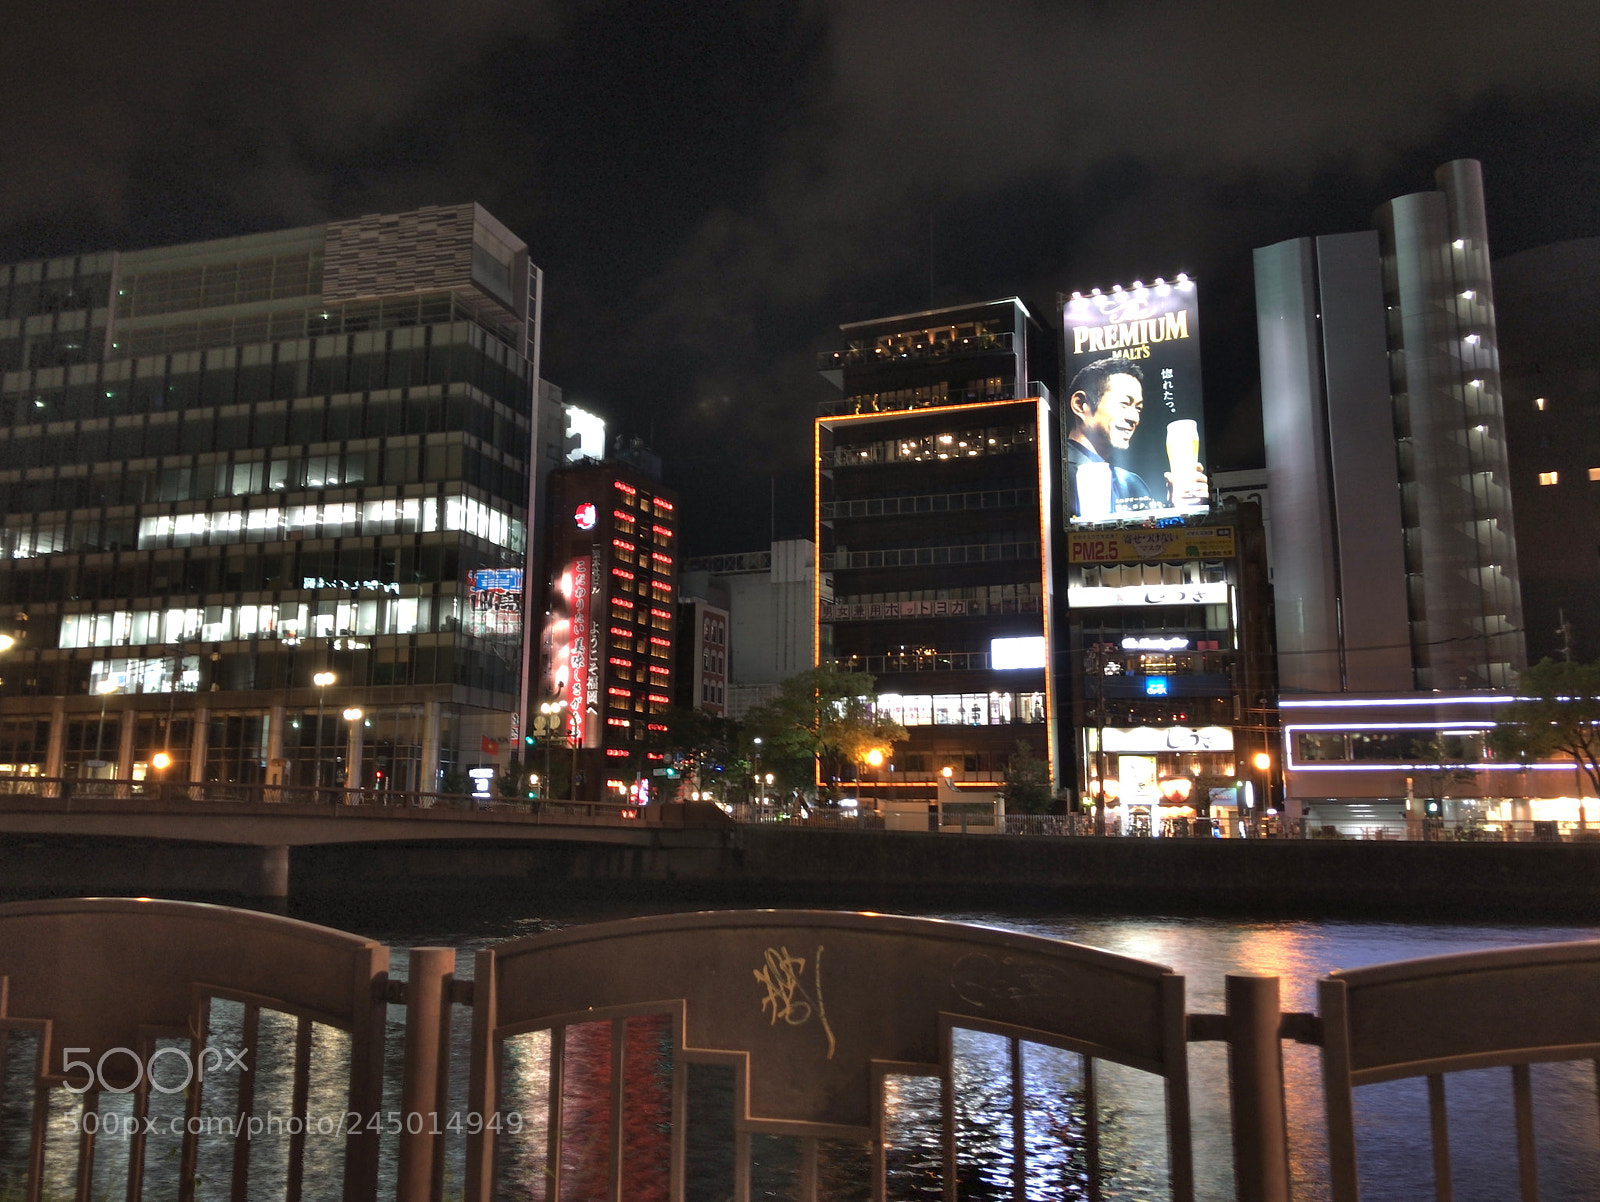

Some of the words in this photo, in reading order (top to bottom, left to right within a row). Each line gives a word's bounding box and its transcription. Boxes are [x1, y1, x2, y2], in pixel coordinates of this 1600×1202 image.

[1073, 310, 1189, 354] PREMIUM
[1112, 344, 1150, 360] MALT'S
[1161, 368, 1176, 413] 惚れたっ。
[1072, 541, 1118, 561] PM2.5
[586, 621, 600, 716] ようこそ福岡へ
